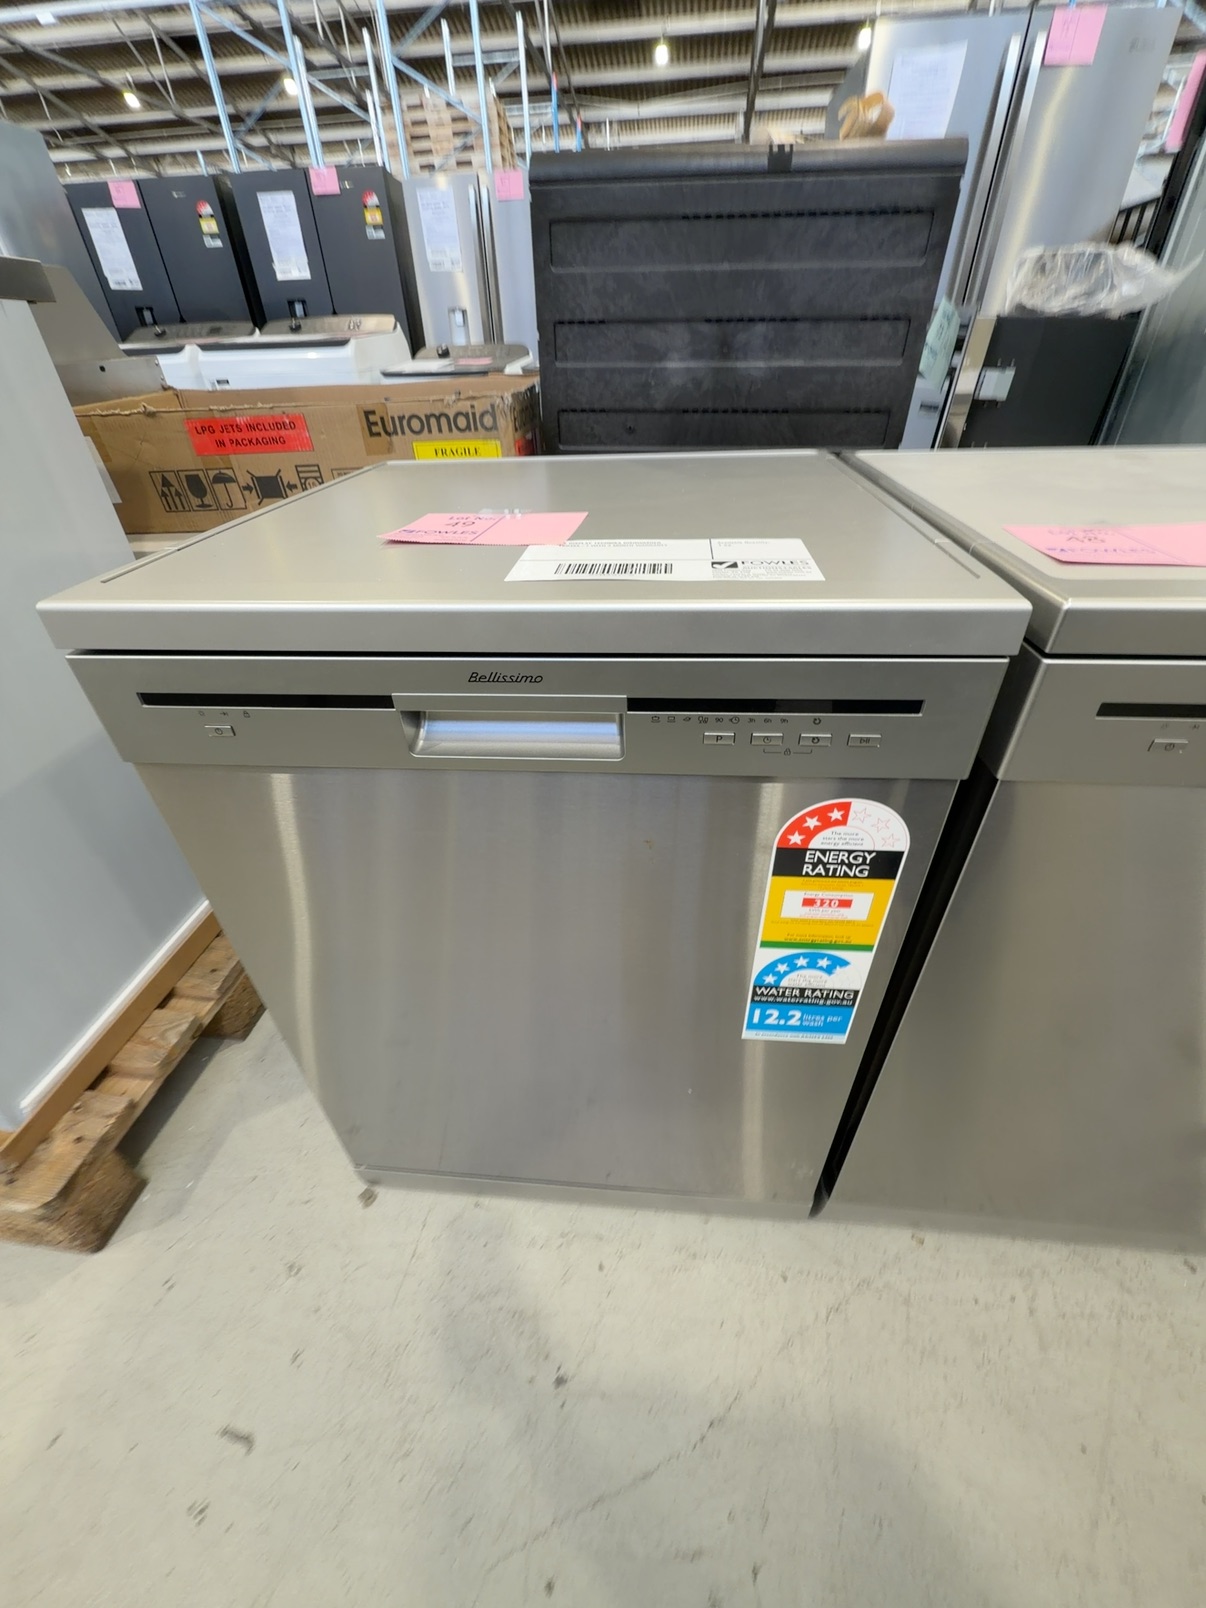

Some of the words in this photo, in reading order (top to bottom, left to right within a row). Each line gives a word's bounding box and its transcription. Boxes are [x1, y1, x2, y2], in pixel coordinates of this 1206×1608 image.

[363, 403, 498, 438] Euromaid
[195, 425, 216, 435] LPG
[219, 423, 243, 434] JETS
[246, 421, 296, 433] INCLUDED
[215, 439, 226, 448] IN
[230, 436, 286, 447] PACKAGING
[434, 446, 481, 457] FRAGILE
[467, 671, 544, 683] Bellissimo
[715, 735, 723, 743] P
[805, 850, 877, 864] ENERGY
[802, 863, 870, 878] RATING
[813, 899, 839, 909] 320
[755, 986, 800, 997] WATER
[804, 989, 854, 1000] RATING
[753, 995, 853, 1006] www.waterrating.gov.au
[752, 1007, 802, 1026] 12.2
[826, 1014, 843, 1023] per
